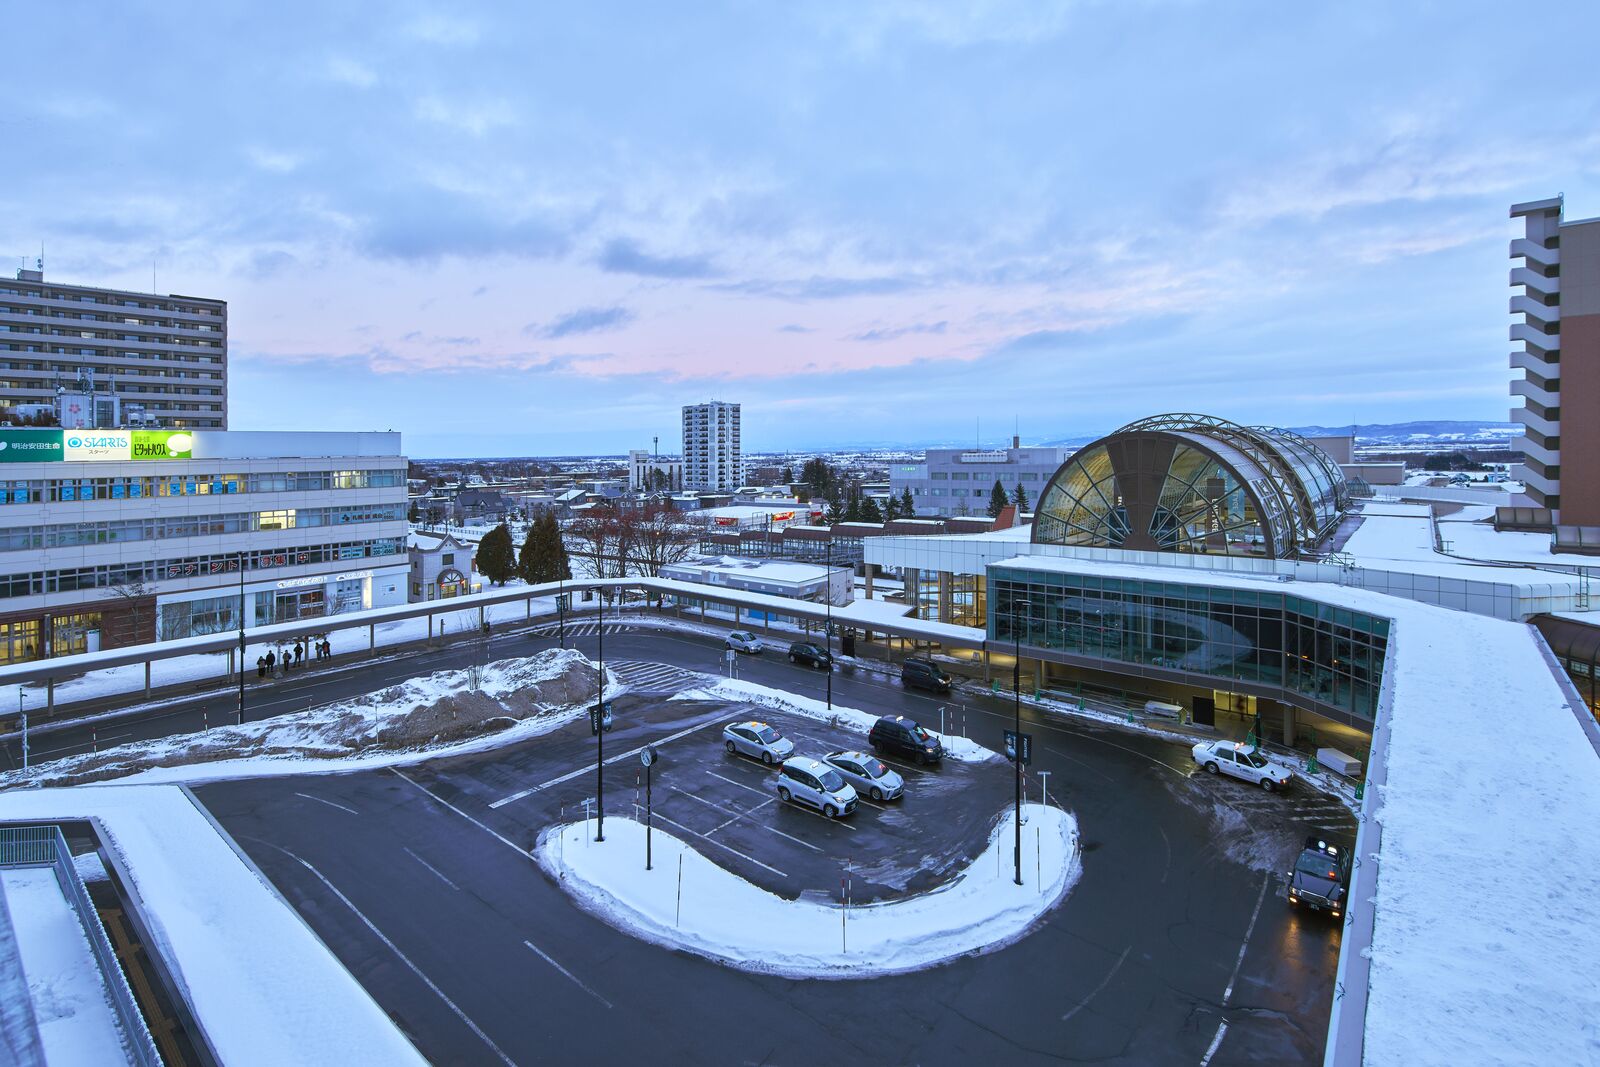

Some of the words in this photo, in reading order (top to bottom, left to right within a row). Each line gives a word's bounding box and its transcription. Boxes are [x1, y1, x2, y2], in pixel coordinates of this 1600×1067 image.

[11, 442, 60, 450] 明治安田生命
